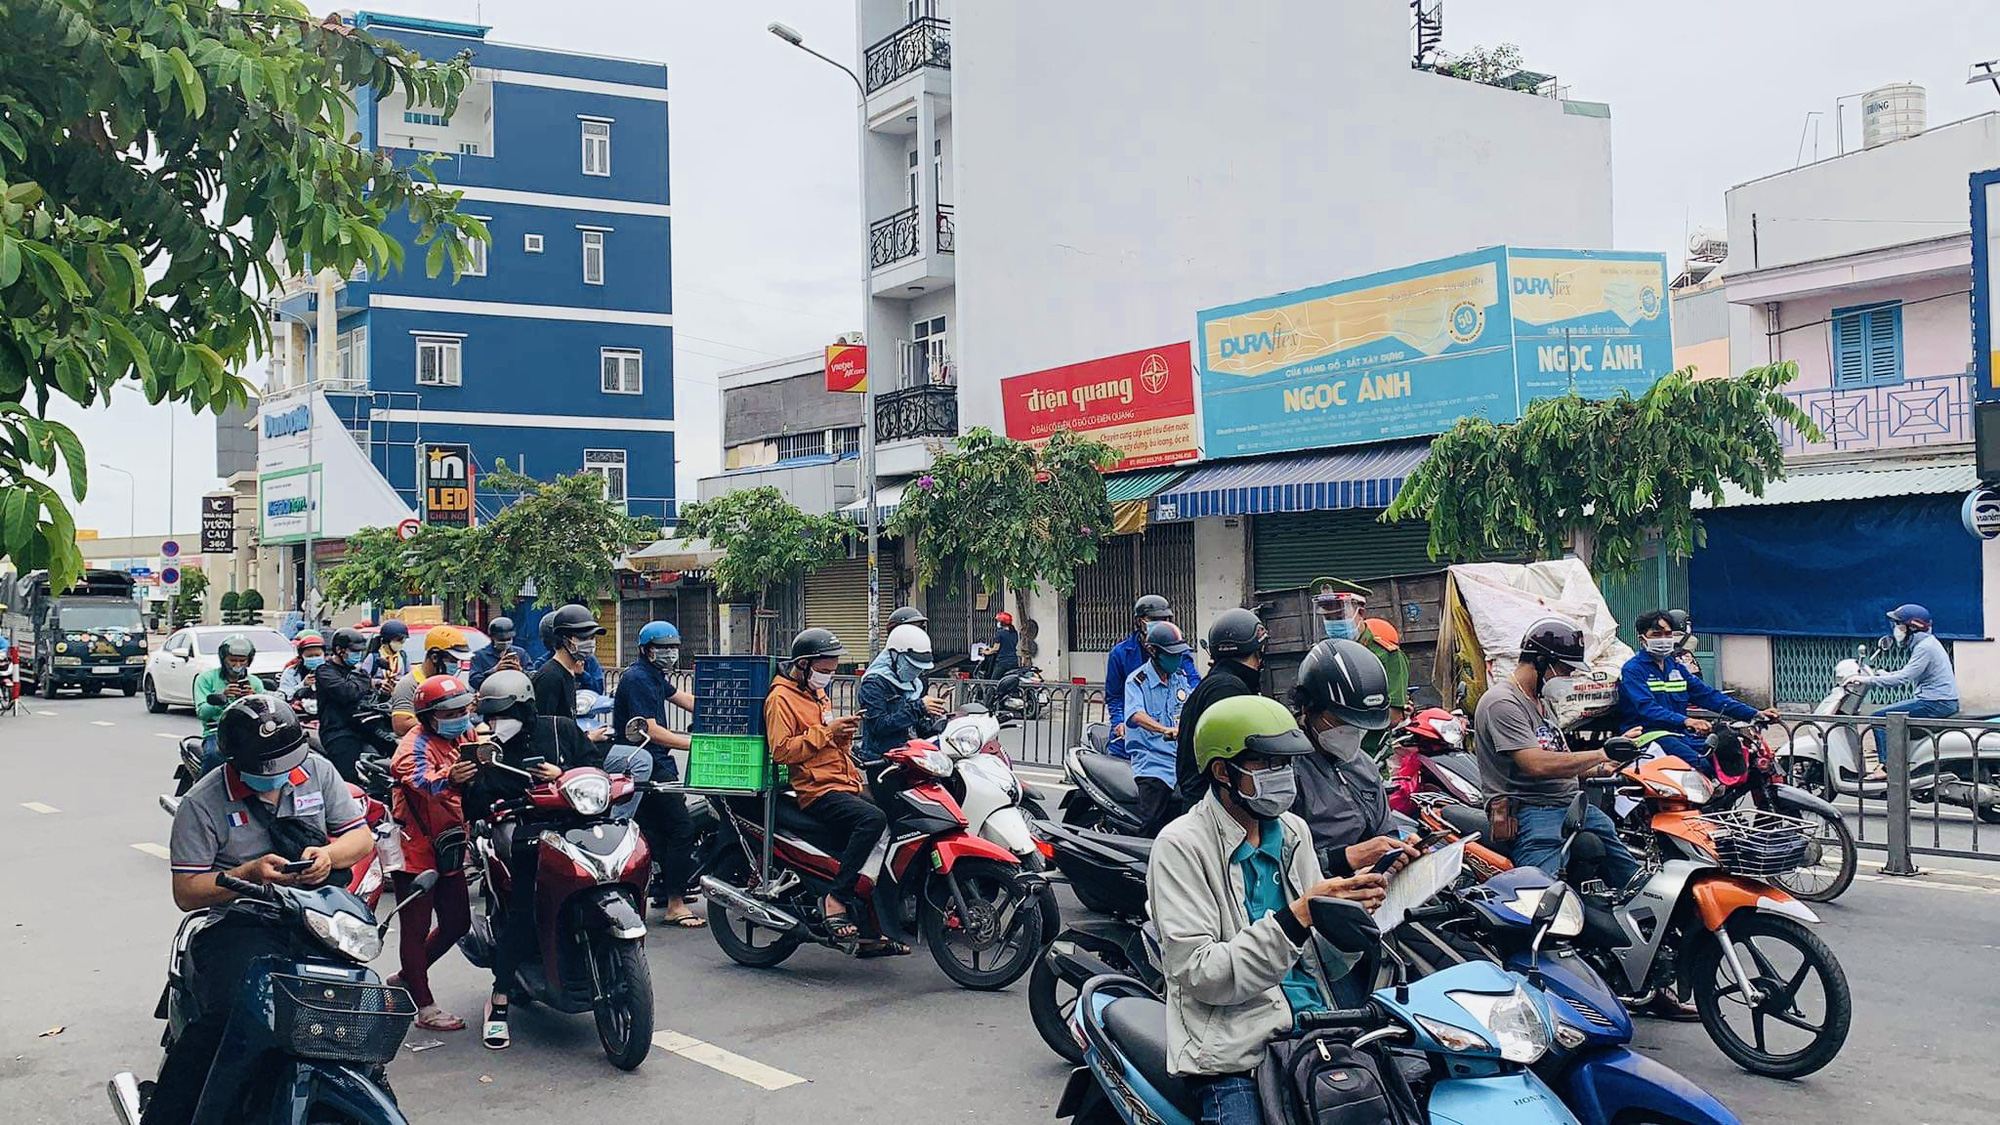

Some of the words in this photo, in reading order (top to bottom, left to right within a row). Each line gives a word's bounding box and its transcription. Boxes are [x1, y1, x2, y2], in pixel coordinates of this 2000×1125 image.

[1457, 310, 1473, 329] 50
[1220, 322, 1298, 359] DURAflex
[1601, 338, 1642, 371] ÁNH
[1021, 387, 1068, 412] điện
[1072, 377, 1133, 412] quang
[1283, 381, 1348, 413] NGỌC
[1357, 370, 1412, 403] ÁNH
[428, 487, 468, 511] LED
[206, 530, 229, 539] CAU
[896, 830, 921, 840] HONDA
[1642, 891, 1664, 901] HONDA
